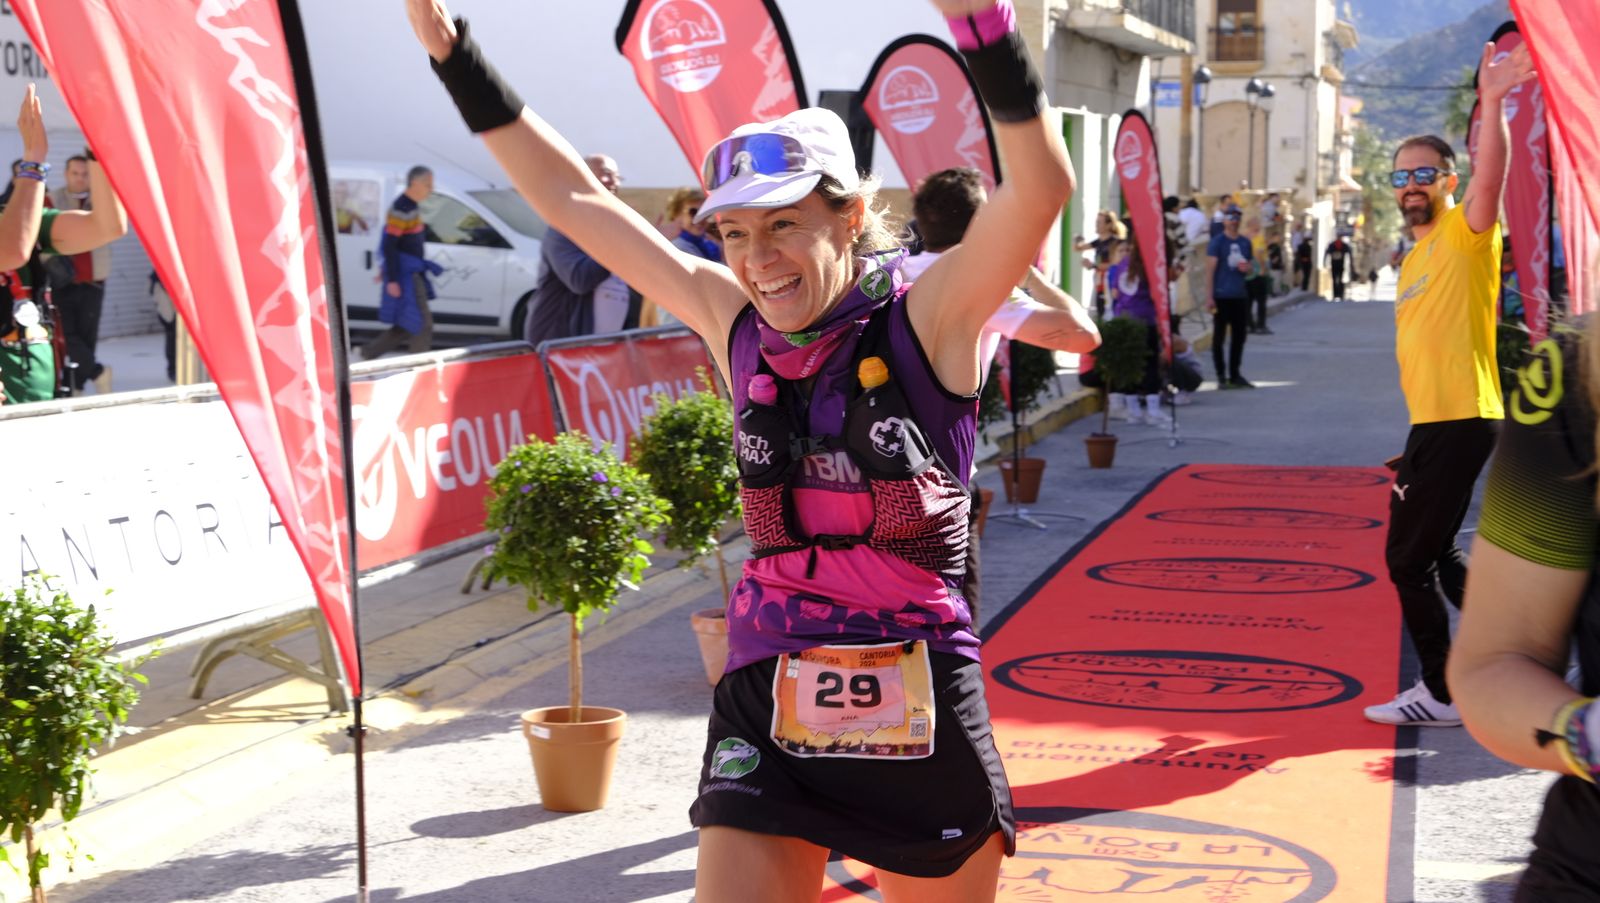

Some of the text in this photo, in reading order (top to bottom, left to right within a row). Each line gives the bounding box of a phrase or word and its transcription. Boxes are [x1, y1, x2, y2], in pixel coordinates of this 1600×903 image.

[0, 41, 48, 79] ORI
[859, 650, 897, 660] CANTORIA
[815, 671, 882, 709] 29
[1002, 752, 1290, 775] Ayuntamient
[1212, 752, 1267, 761] de
[1203, 843, 1272, 857] LA
